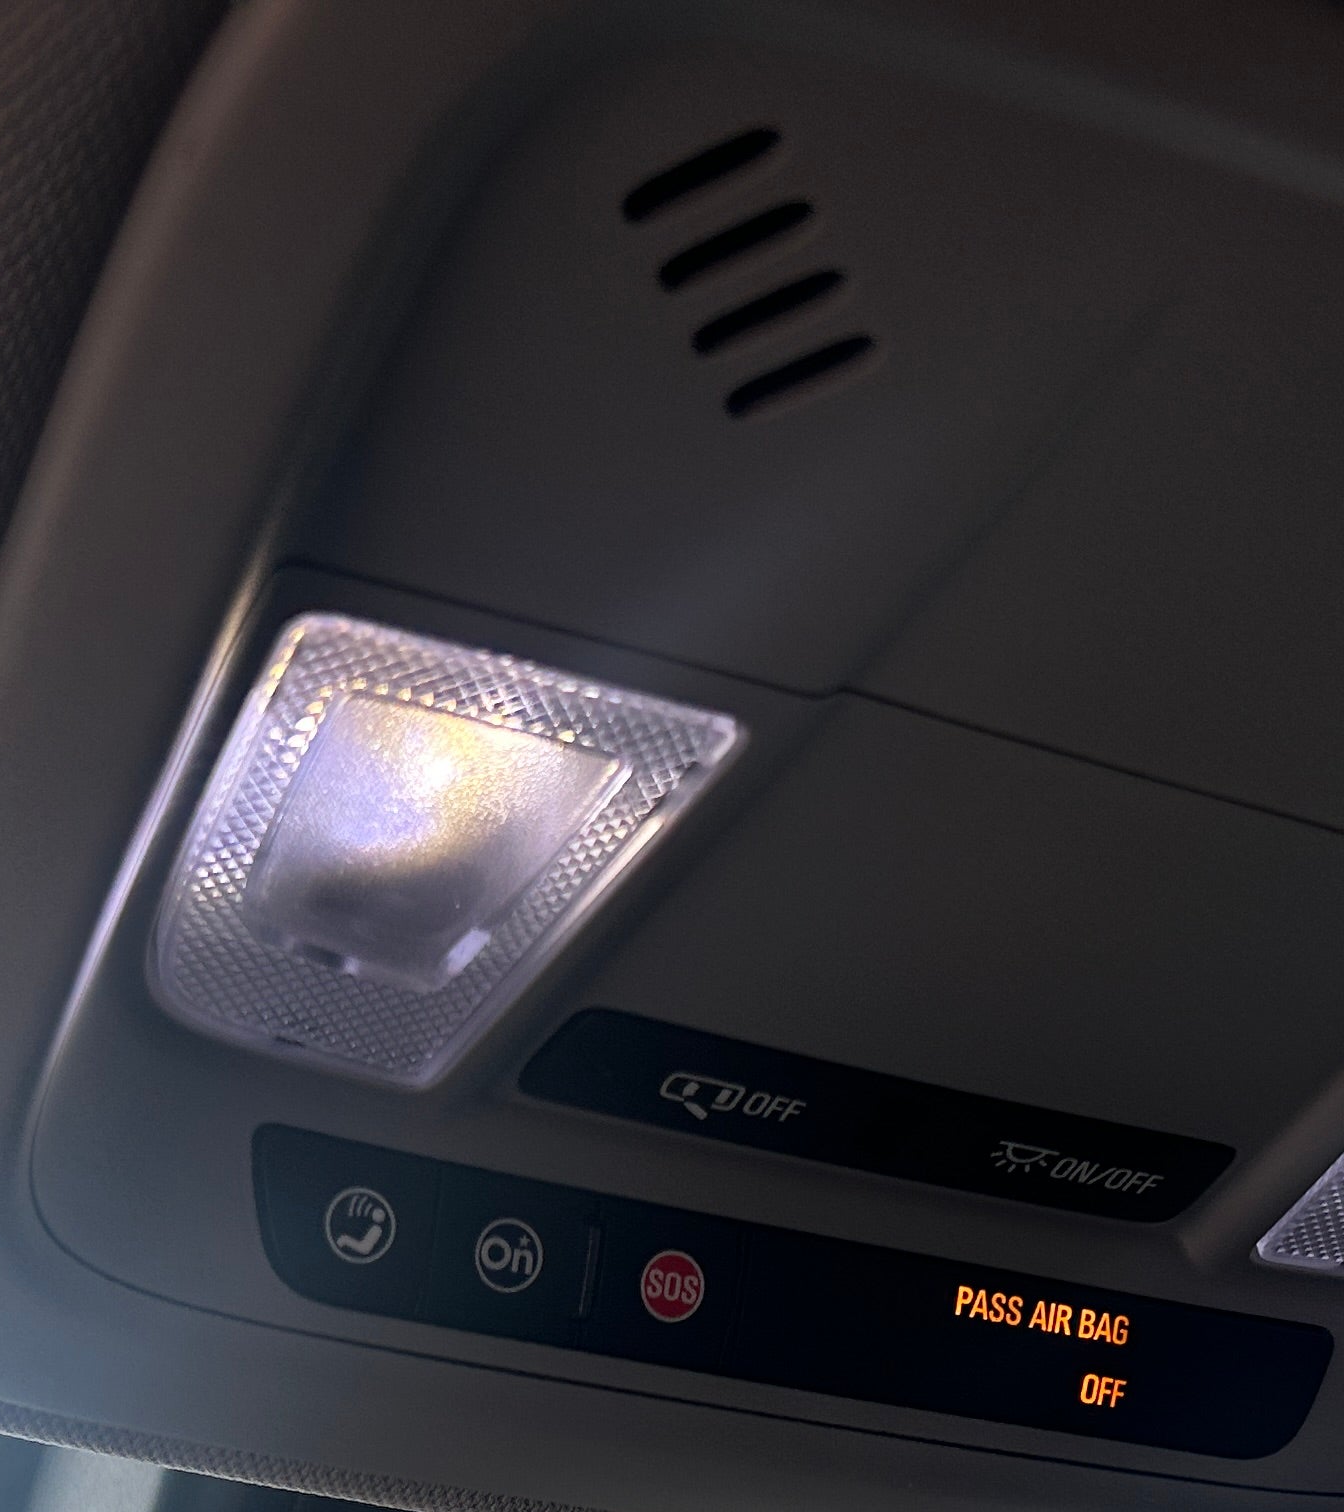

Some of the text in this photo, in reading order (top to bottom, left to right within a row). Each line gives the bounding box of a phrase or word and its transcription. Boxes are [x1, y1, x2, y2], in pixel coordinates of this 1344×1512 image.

[742, 1091, 807, 1122] OFF
[1049, 1156, 1165, 1195] ON/OFF
[646, 1267, 699, 1305] SOS
[954, 1285, 1130, 1345] PASS AIR BAG
[1079, 1373, 1128, 1408] OFF
